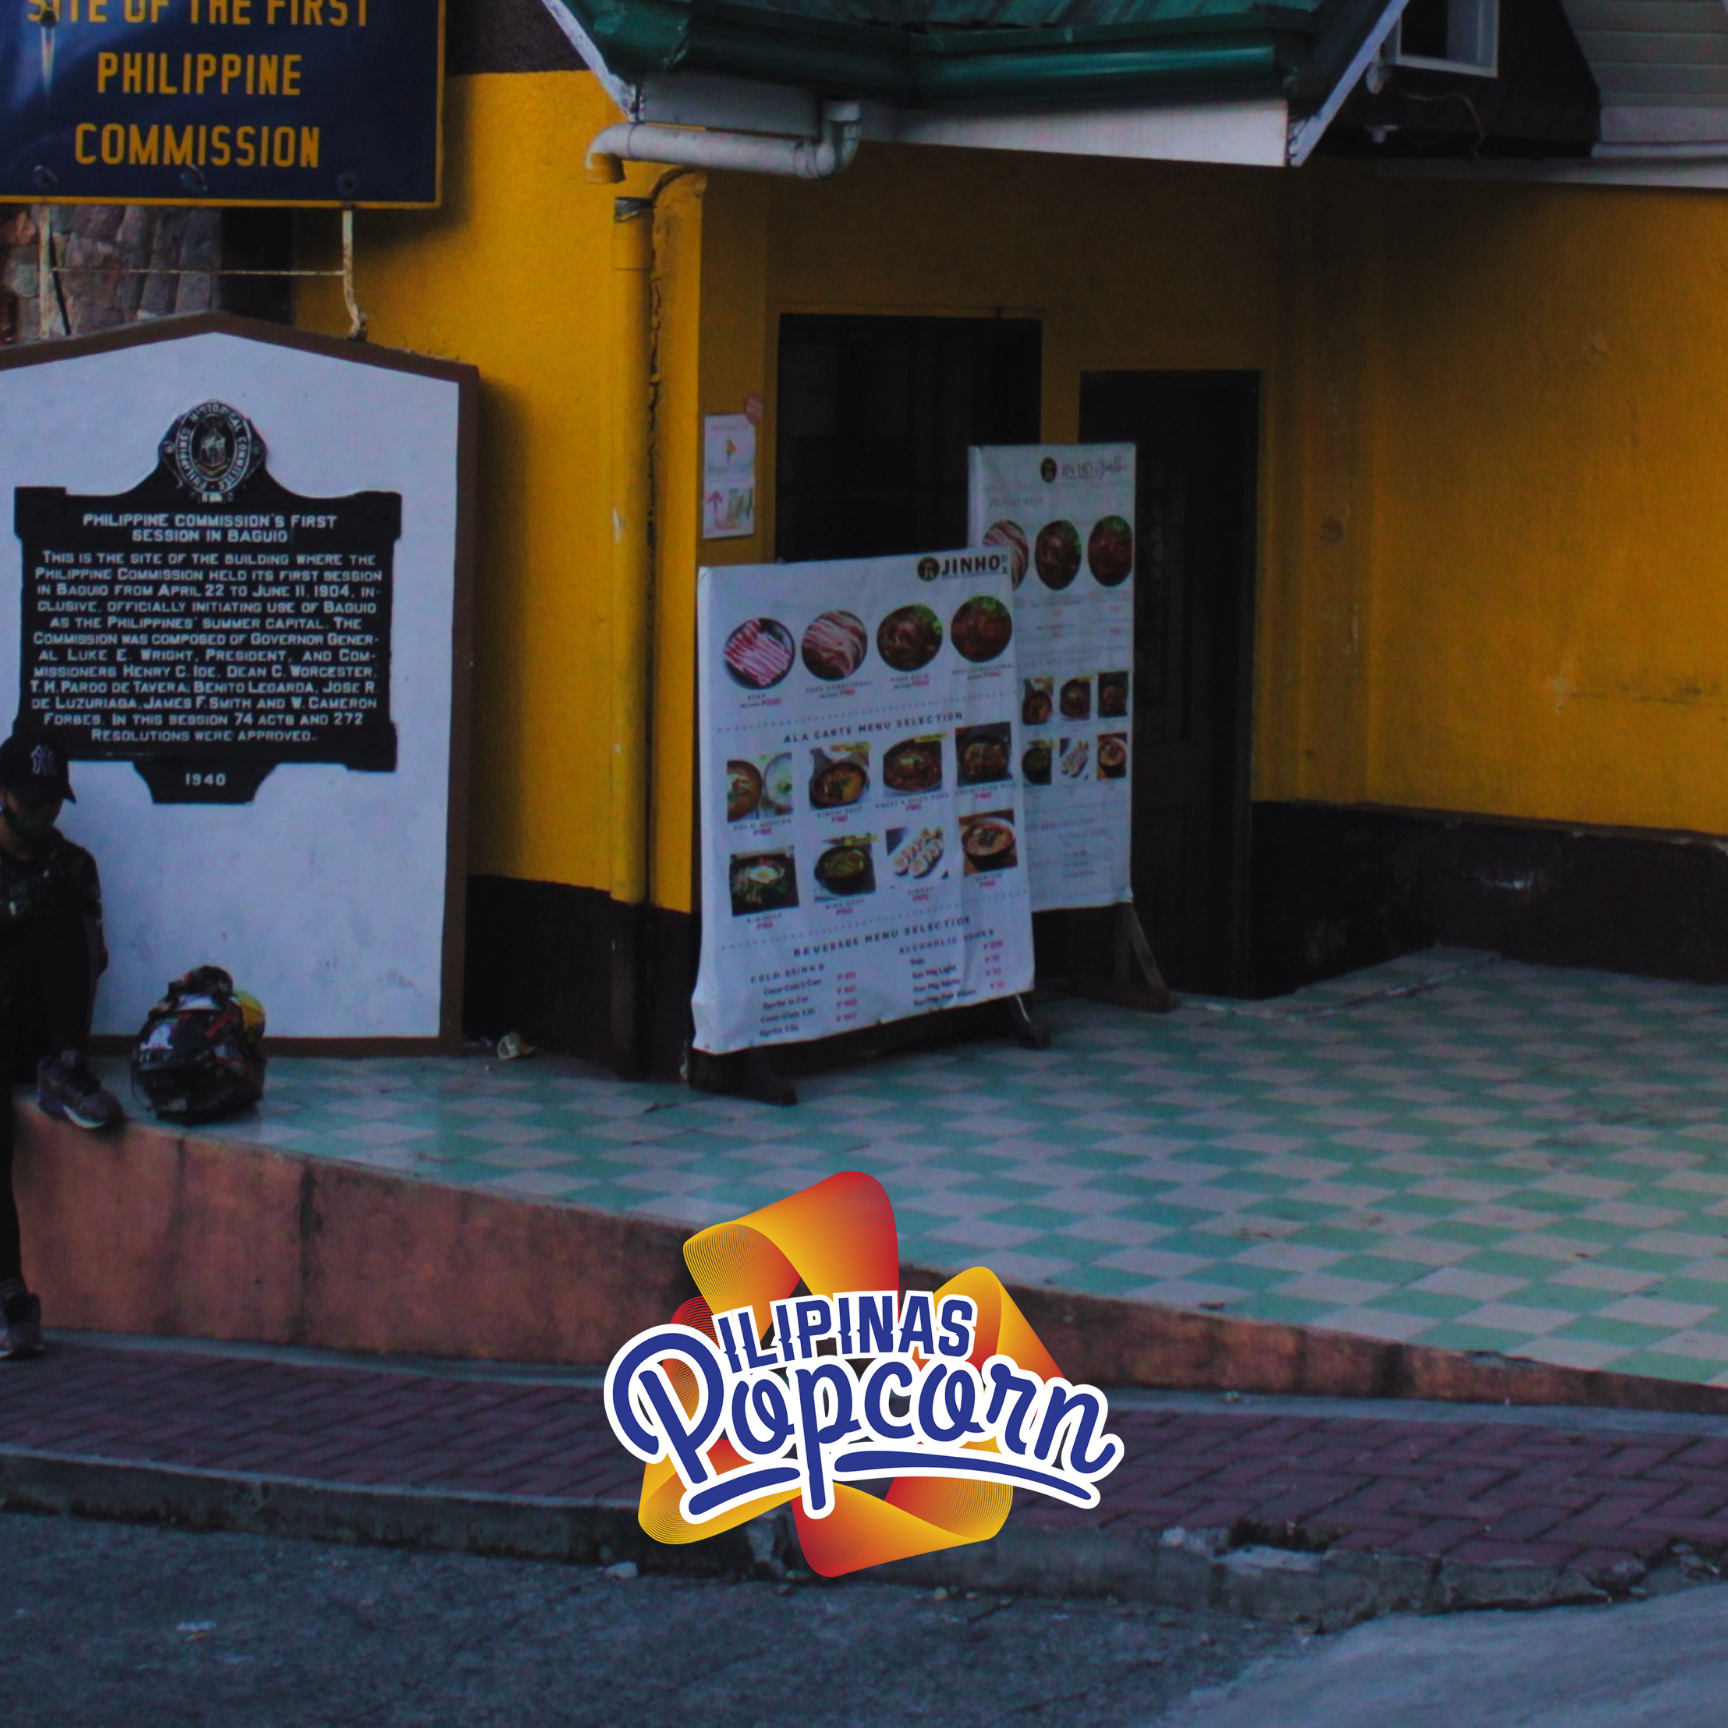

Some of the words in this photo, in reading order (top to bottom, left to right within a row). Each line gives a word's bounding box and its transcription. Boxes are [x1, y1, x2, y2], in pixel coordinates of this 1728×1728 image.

[97, 52, 302, 96] PHILIPPINE
[74, 122, 320, 169] COMMISSION
[83, 513, 169, 527] PHILIPPINE
[174, 513, 285, 528] COMMISSION'S
[290, 514, 338, 529] FIRST
[132, 529, 200, 543] SESSION
[206, 529, 222, 543] IN
[227, 529, 288, 543] BAGUIO
[42, 550, 74, 564] THIS
[79, 552, 92, 564] IS
[96, 552, 124, 564] THE
[130, 552, 162, 564] SITE
[168, 552, 184, 564] OF
[191, 553, 219, 565] THE
[225, 553, 289, 565] BUILDING
[296, 553, 343, 566] WHERE
[349, 554, 376, 566] THE
[941, 554, 1001, 576] JINHO
[35, 567, 112, 581] PHILIPPINE
[117, 567, 203, 581] COMMISSION
[209, 569, 247, 582] HELD
[252, 569, 274, 582] ITS
[279, 569, 319, 582] FIRST
[323, 569, 383, 582] SESSION
[37, 584, 51, 596] IN
[56, 583, 109, 596] BAGUIO
[114, 584, 153, 597] FROM
[157, 583, 202, 597] APRIL
[204, 584, 225, 597] 22
[230, 585, 248, 597] TO
[252, 584, 290, 597] JUNE
[107, 601, 187, 613] OFFICIALLY
[192, 601, 262, 614] INITIATING
[267, 602, 296, 614] USE
[301, 602, 320, 614] OF
[323, 600, 377, 614] BAGUIO
[49, 617, 70, 629] AS
[74, 617, 102, 629] THE
[202, 617, 261, 630] SUMMER
[333, 617, 362, 630] THE
[33, 632, 117, 645] COMMISSION
[121, 633, 149, 645] WAS
[151, 633, 226, 646] COMPOSED
[229, 634, 247, 645] OF
[250, 632, 324, 646] GOVERNOR
[38, 649, 59, 662] AL
[67, 648, 108, 662] LUKE
[302, 650, 332, 662] AND
[33, 666, 117, 678] MISSIONERS
[123, 664, 171, 678] HENRY
[226, 665, 267, 678] DEAN
[61, 680, 108, 694] PARDO
[112, 681, 130, 693] DE
[193, 680, 245, 694] BENITO
[322, 681, 360, 694] JOSE
[31, 697, 50, 709] DE
[143, 696, 192, 710] JAMES
[209, 696, 252, 710] SMITH
[256, 698, 286, 710] AND
[308, 696, 378, 710] CAMERON
[111, 713, 126, 725] IN
[132, 714, 163, 725] THIS
[168, 714, 228, 726] SESSION
[234, 712, 253, 726] 74
[257, 714, 295, 726] ACTS
[300, 714, 329, 726] AND
[333, 712, 364, 726] 272
[813, 727, 852, 740] CARTE
[858, 721, 892, 734] MENU
[896, 711, 964, 729] SELECTION
[91, 728, 190, 742] RESOLUTIONS
[194, 730, 234, 742] WERE
[184, 773, 227, 786] 1940
